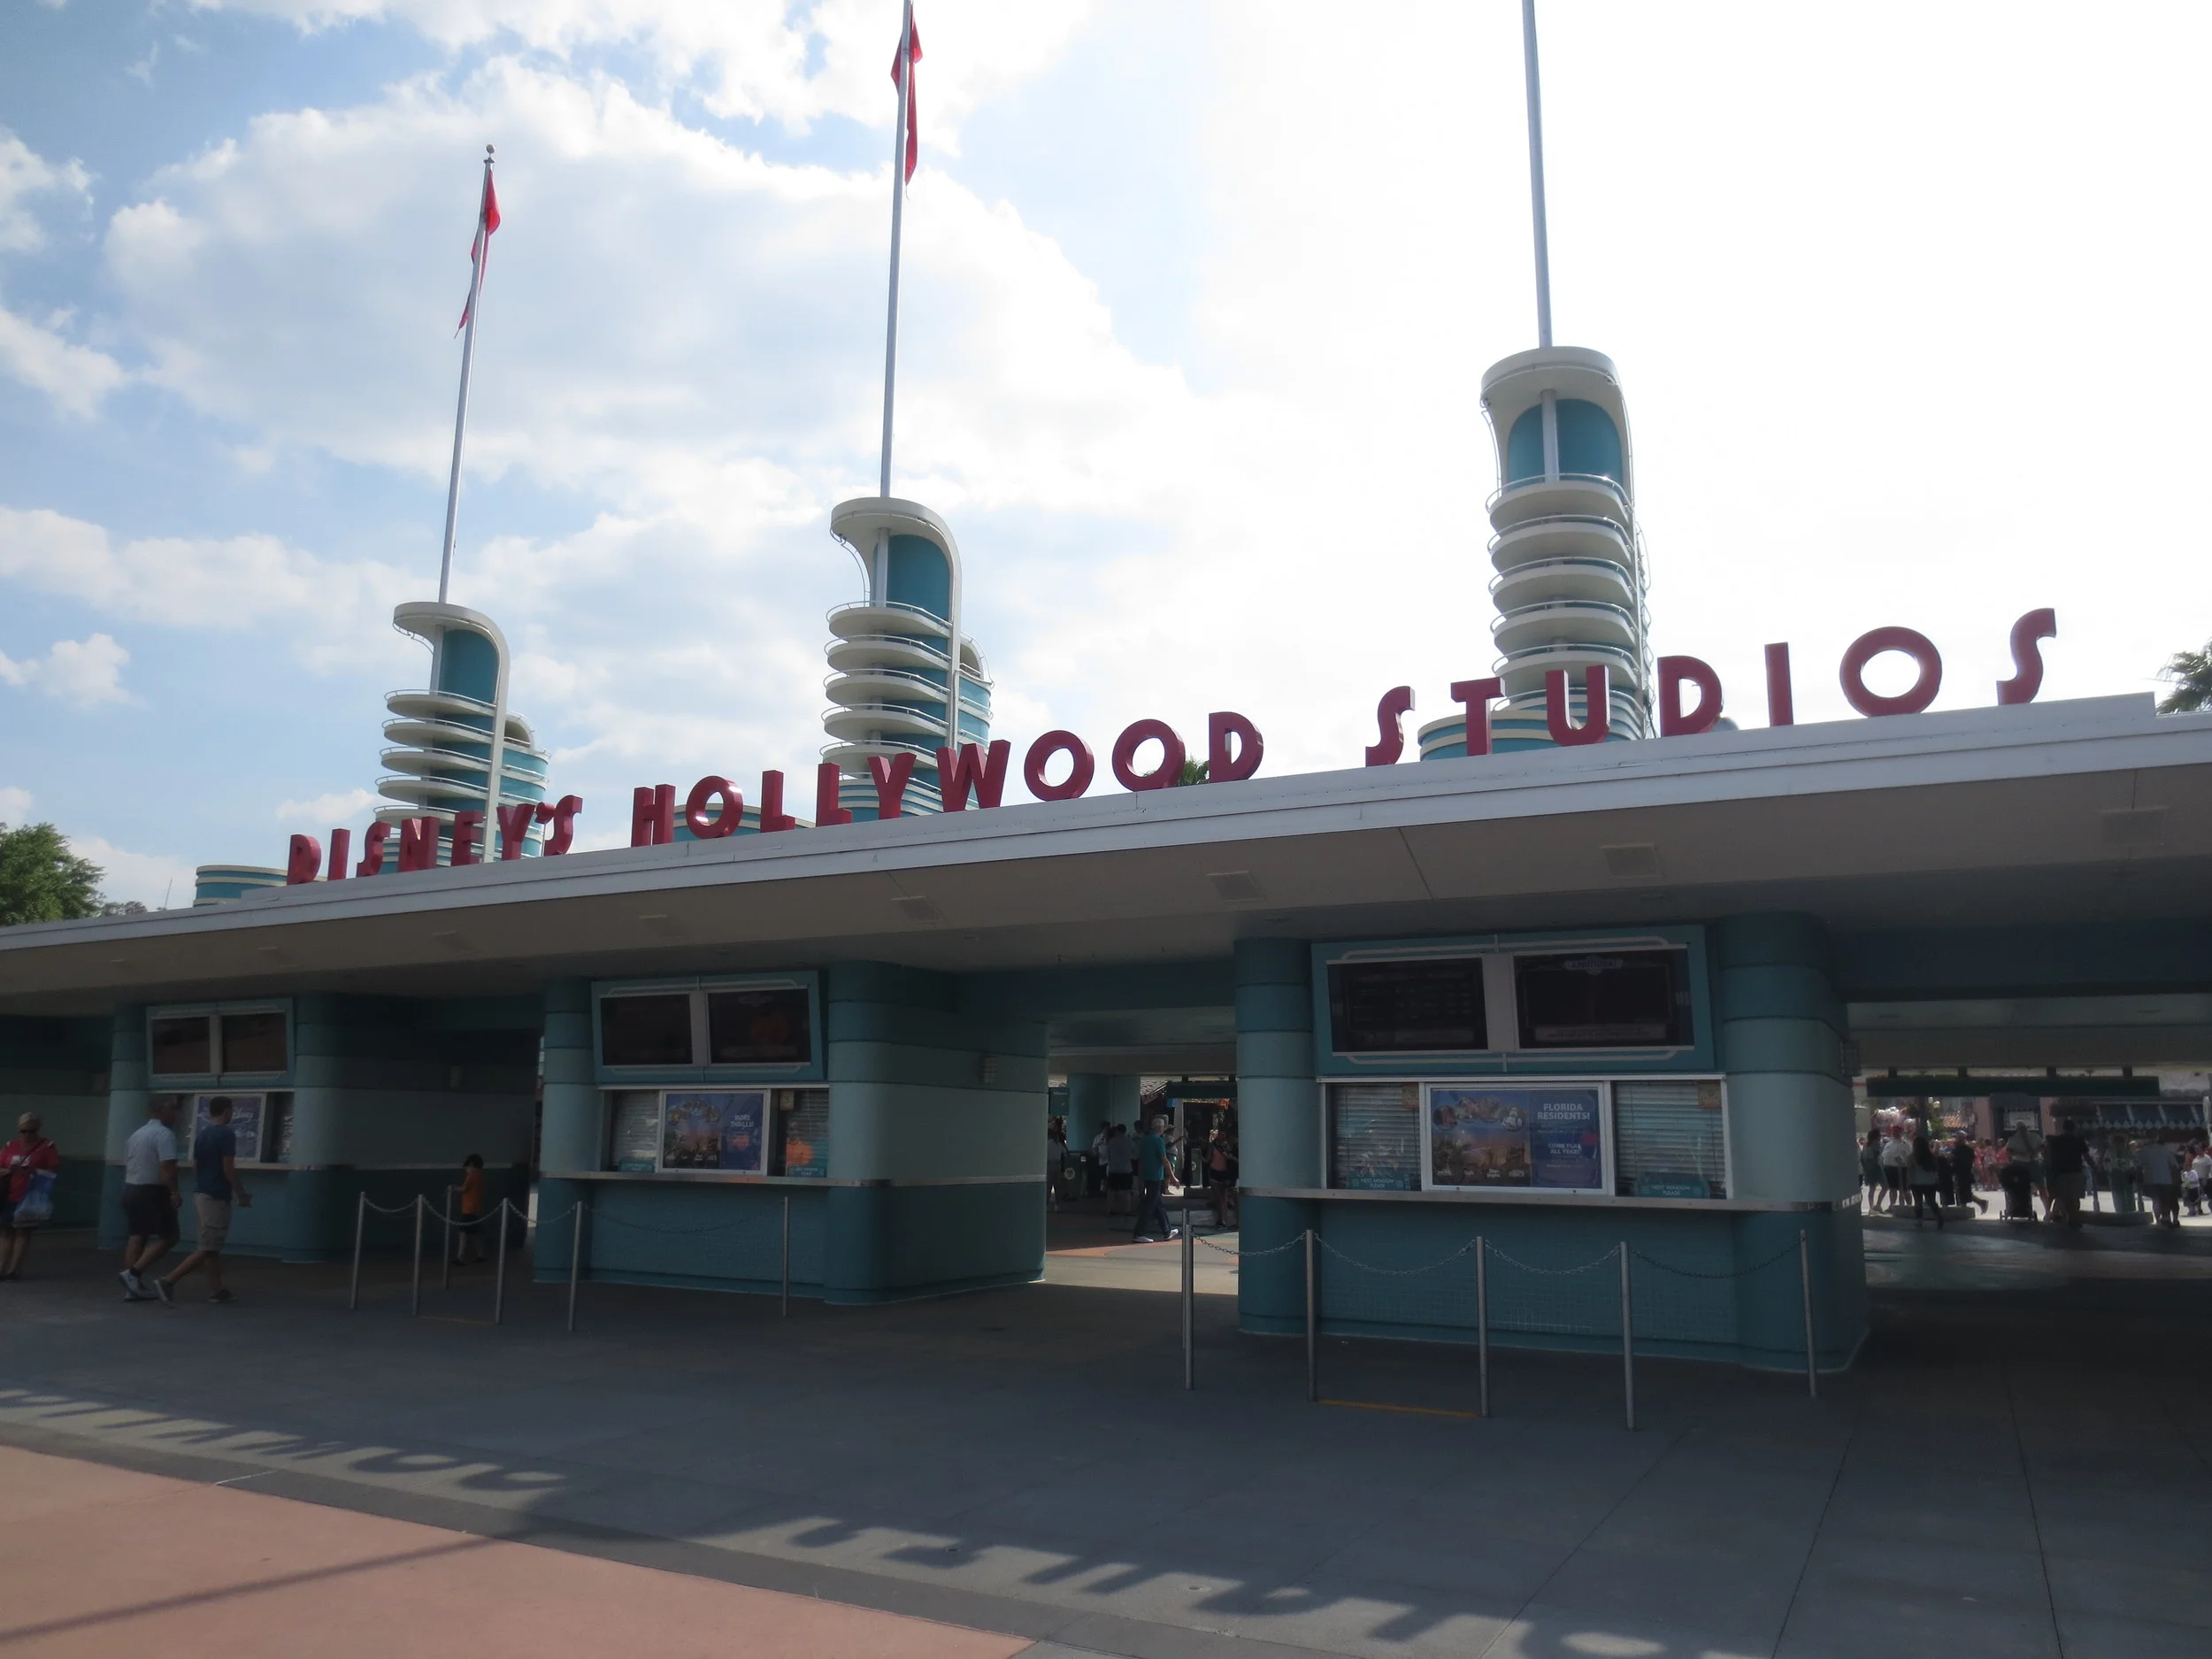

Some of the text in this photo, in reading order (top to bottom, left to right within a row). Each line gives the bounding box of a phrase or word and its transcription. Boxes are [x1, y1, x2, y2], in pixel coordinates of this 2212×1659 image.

[287, 608, 2056, 885] DISNEY'S HOLLYWOOD STUDIOS
